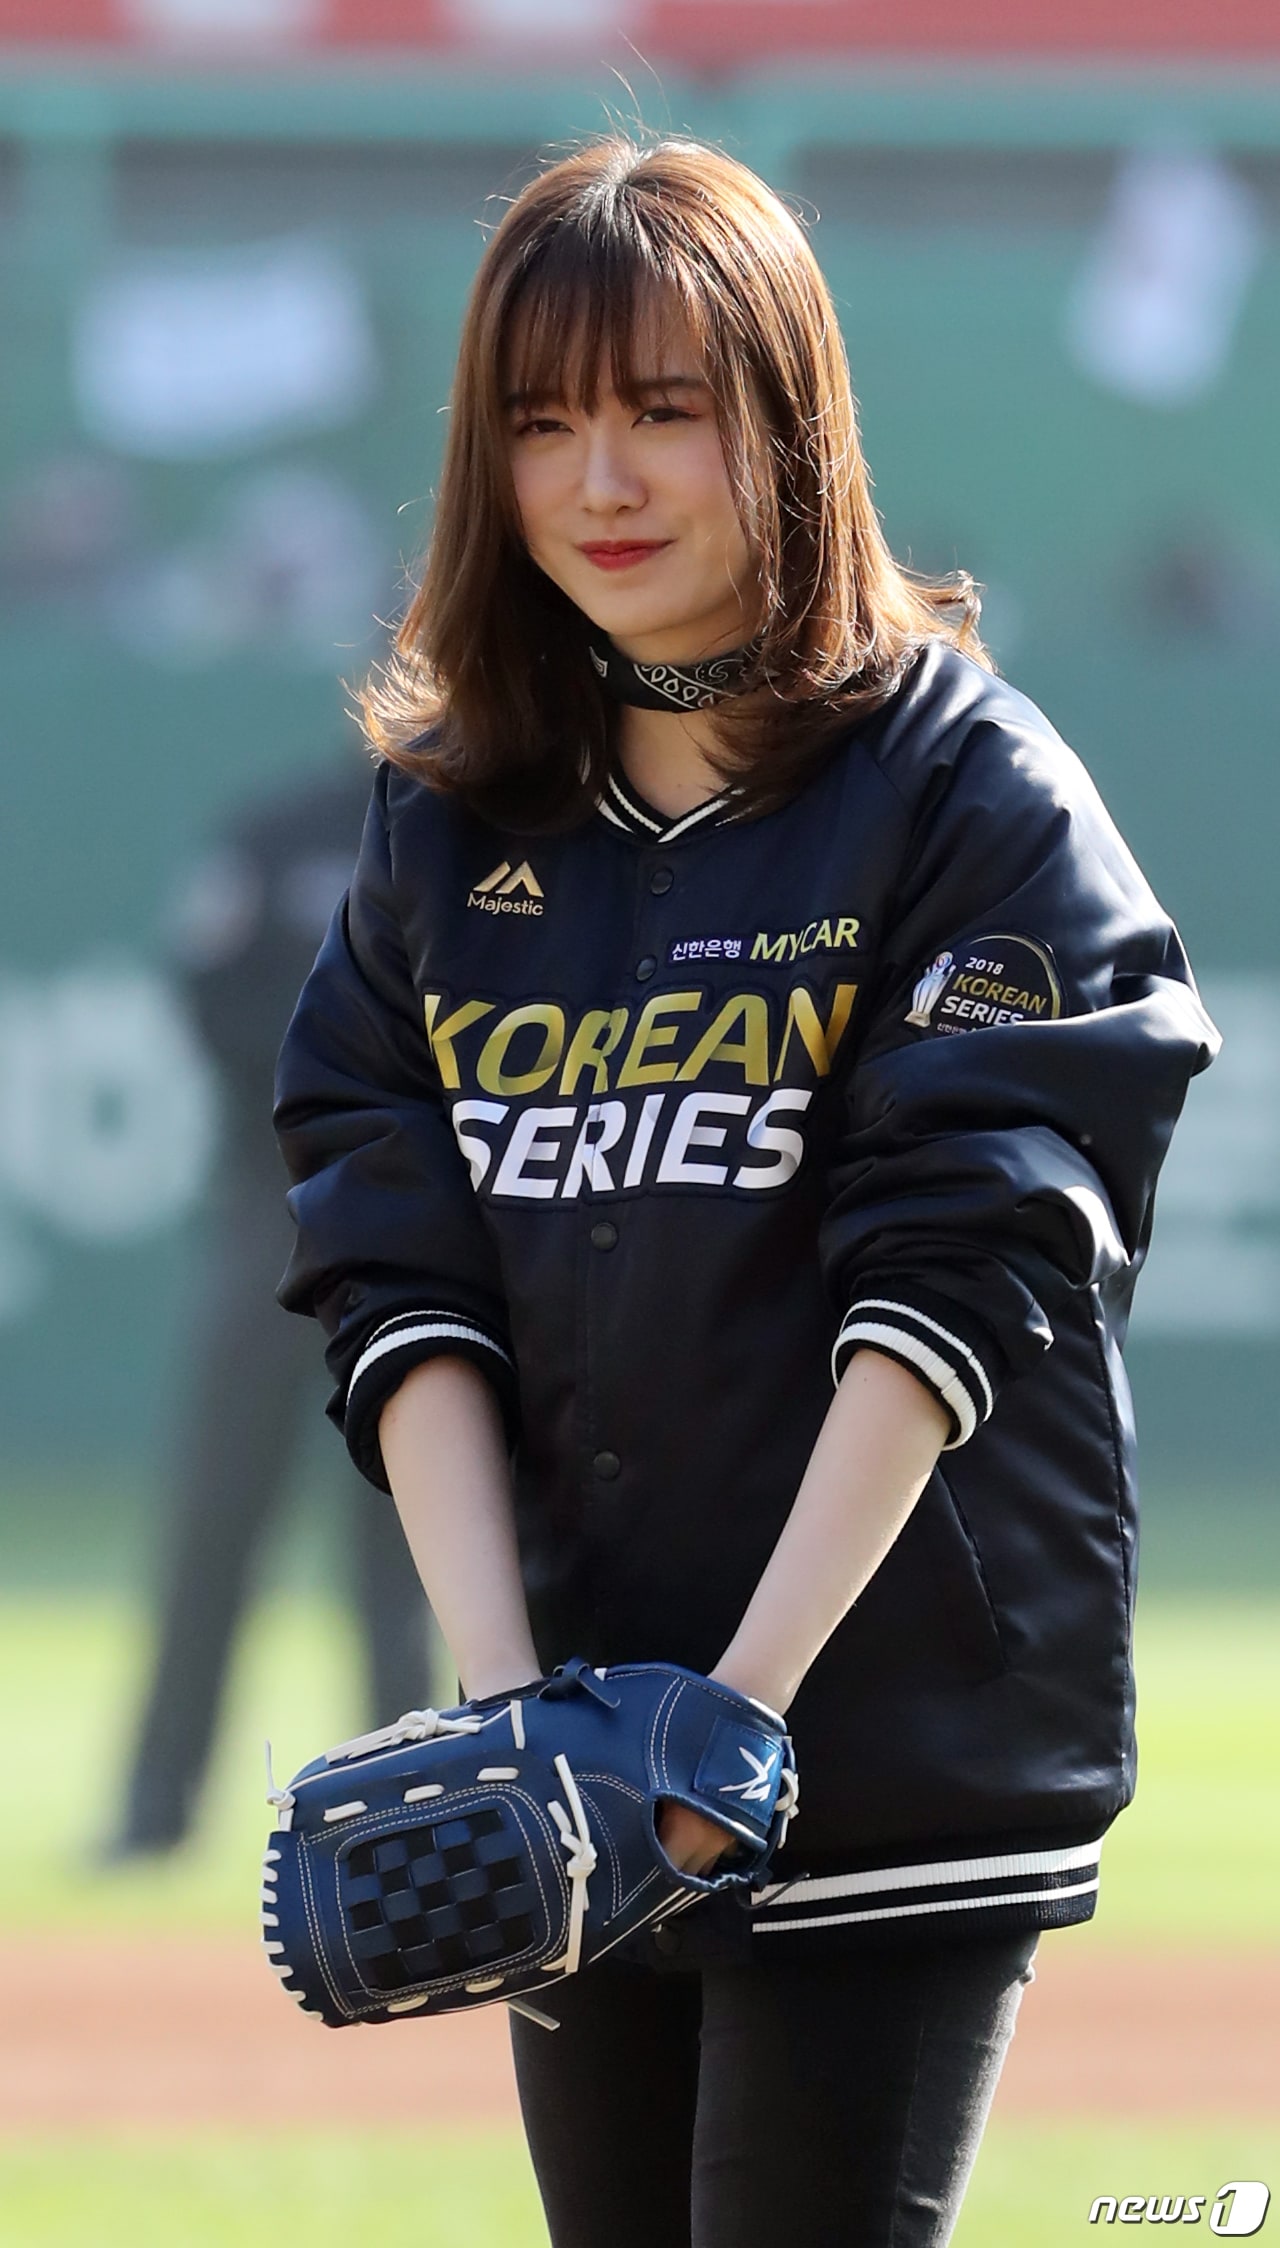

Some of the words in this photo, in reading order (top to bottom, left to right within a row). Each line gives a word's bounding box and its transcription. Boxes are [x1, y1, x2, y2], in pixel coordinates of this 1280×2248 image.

[467, 892, 544, 916] Majestic
[672, 939, 742, 961] 신한은행
[965, 956, 1004, 975] 2018
[952, 973, 1047, 1015] KOREAN
[424, 984, 858, 1097] KOREAN
[452, 1089, 812, 1199] SERIES
